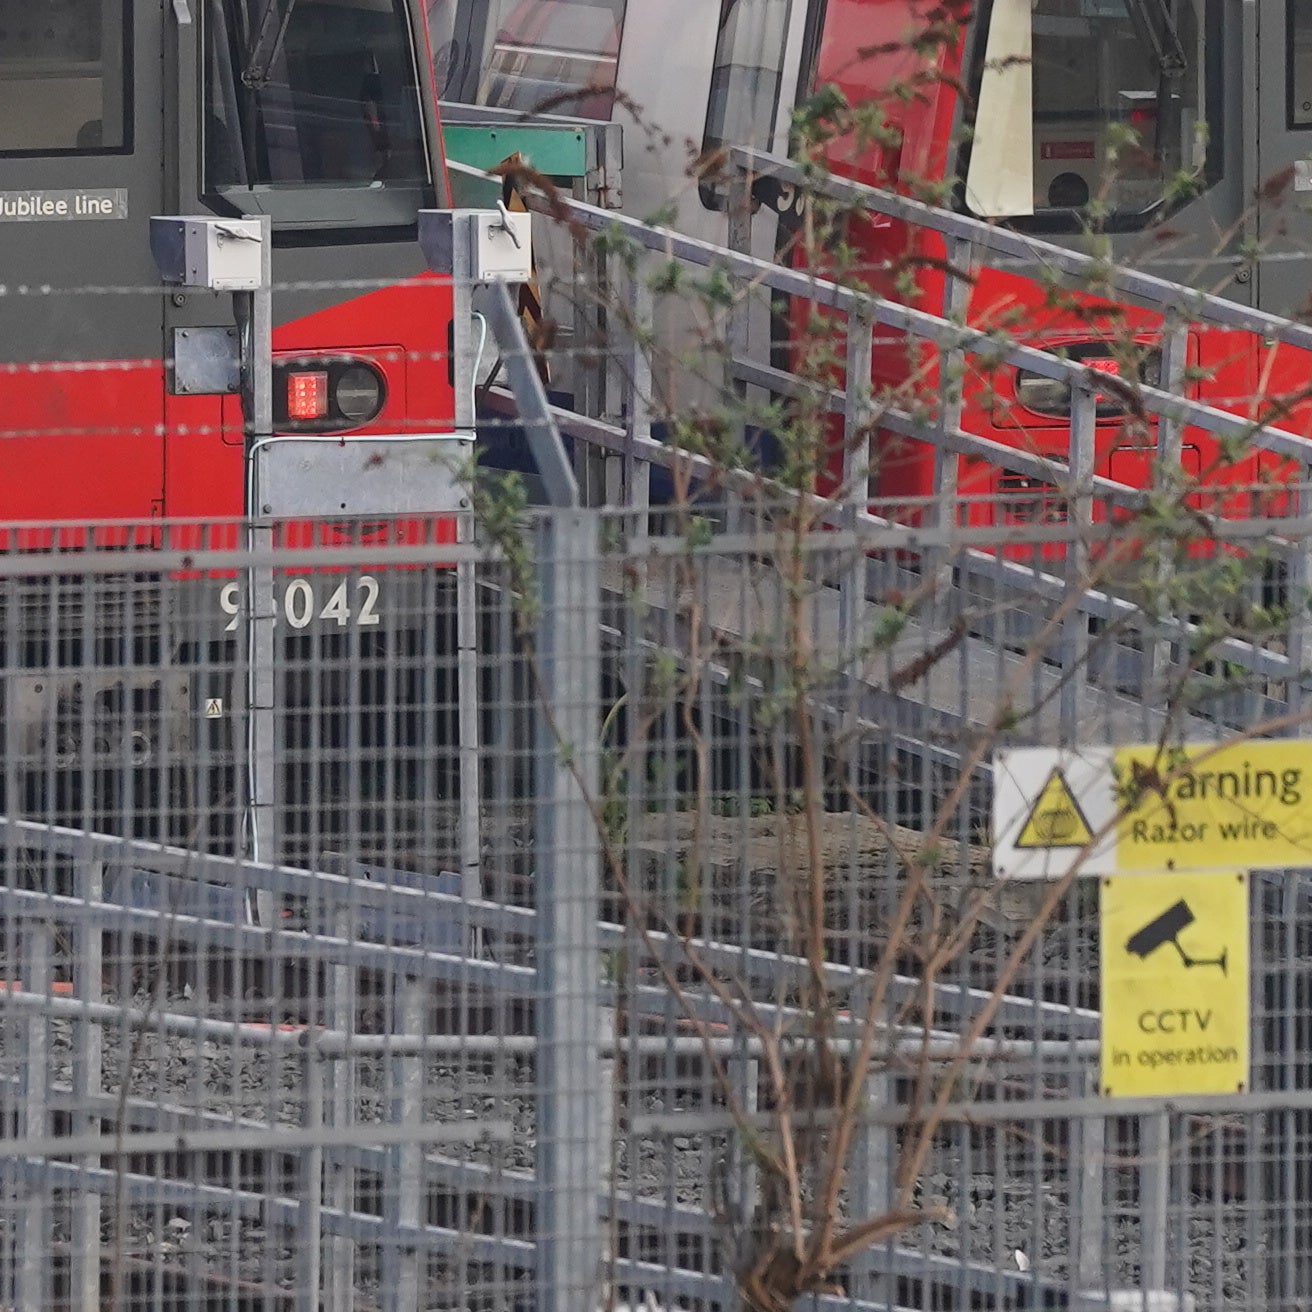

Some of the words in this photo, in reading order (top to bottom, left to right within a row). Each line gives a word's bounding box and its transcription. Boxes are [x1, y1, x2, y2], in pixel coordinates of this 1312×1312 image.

[75, 195, 113, 214] line
[220, 575, 380, 631] 9042
[1134, 761, 1302, 806] arning
[1219, 816, 1278, 841] wire
[1138, 1009, 1212, 1033] CCTV
[1112, 1046, 1131, 1066] in
[1137, 1046, 1238, 1069] operation
